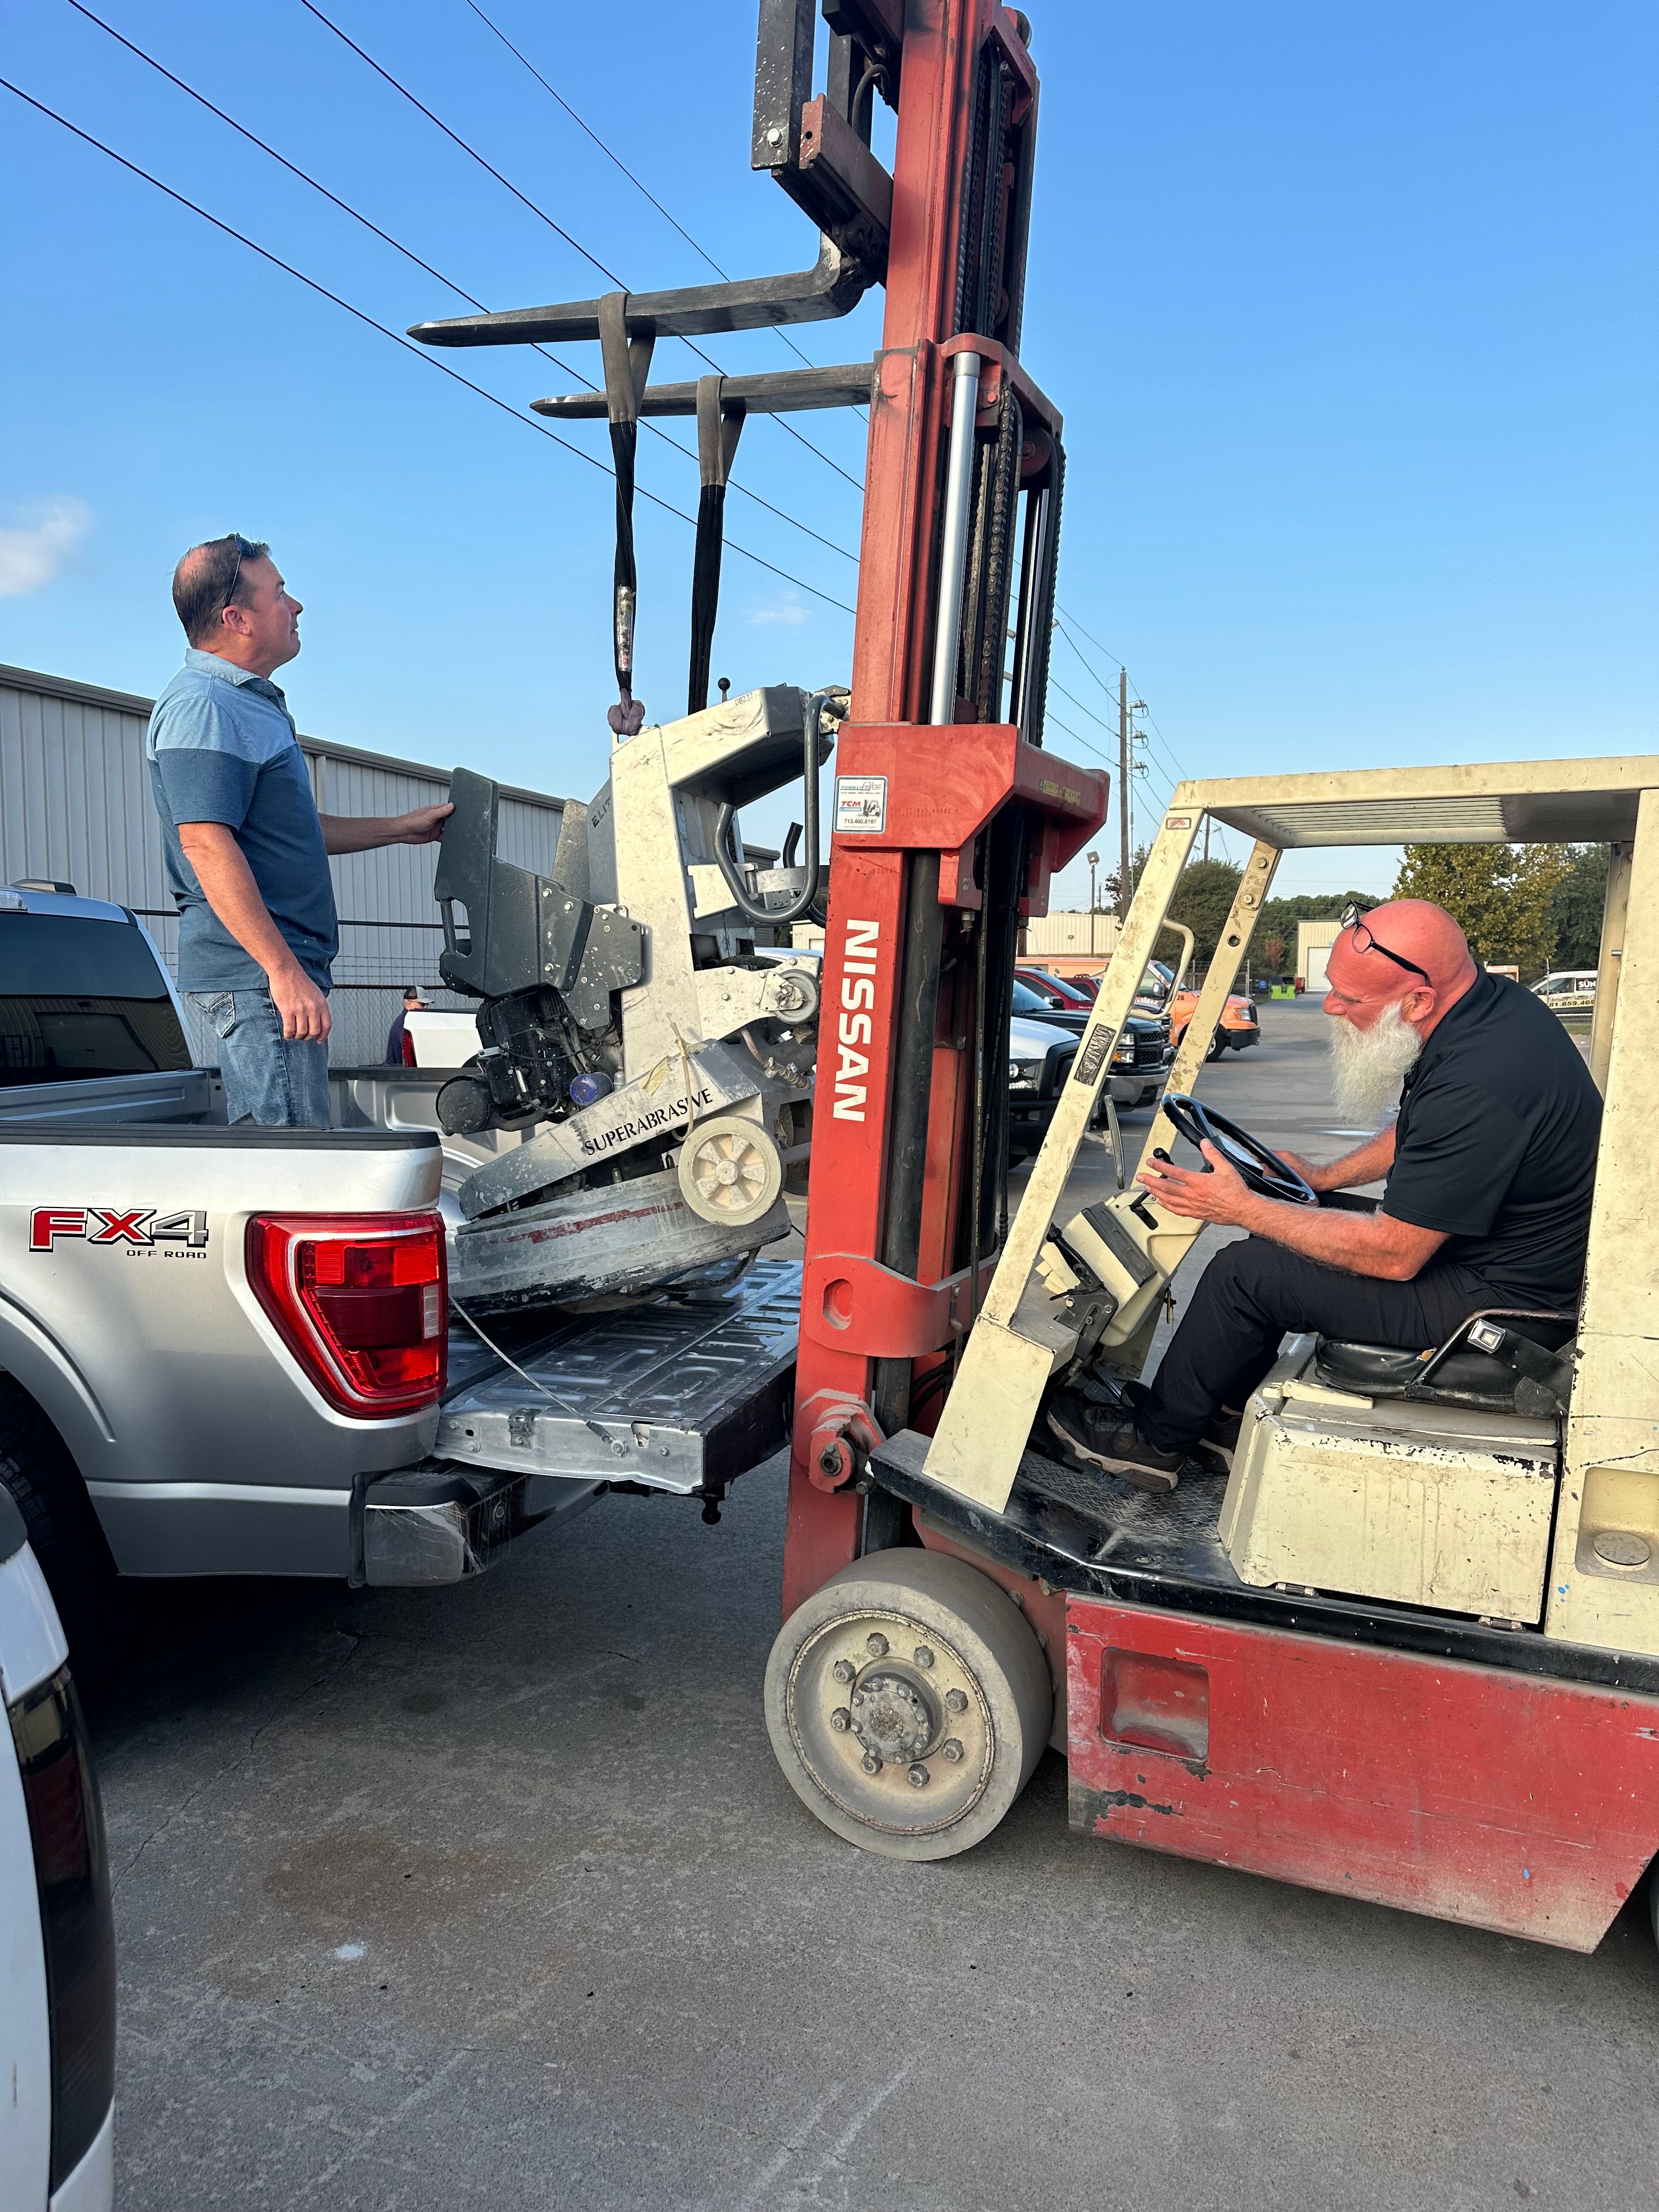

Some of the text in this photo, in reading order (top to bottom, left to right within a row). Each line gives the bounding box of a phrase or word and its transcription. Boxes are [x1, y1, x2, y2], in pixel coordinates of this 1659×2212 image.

[735, 692, 753, 706] 08237
[832, 918, 879, 1122] NISSAN
[29, 1206, 209, 1252] FX4
[164, 1250, 207, 1259] ROAD
